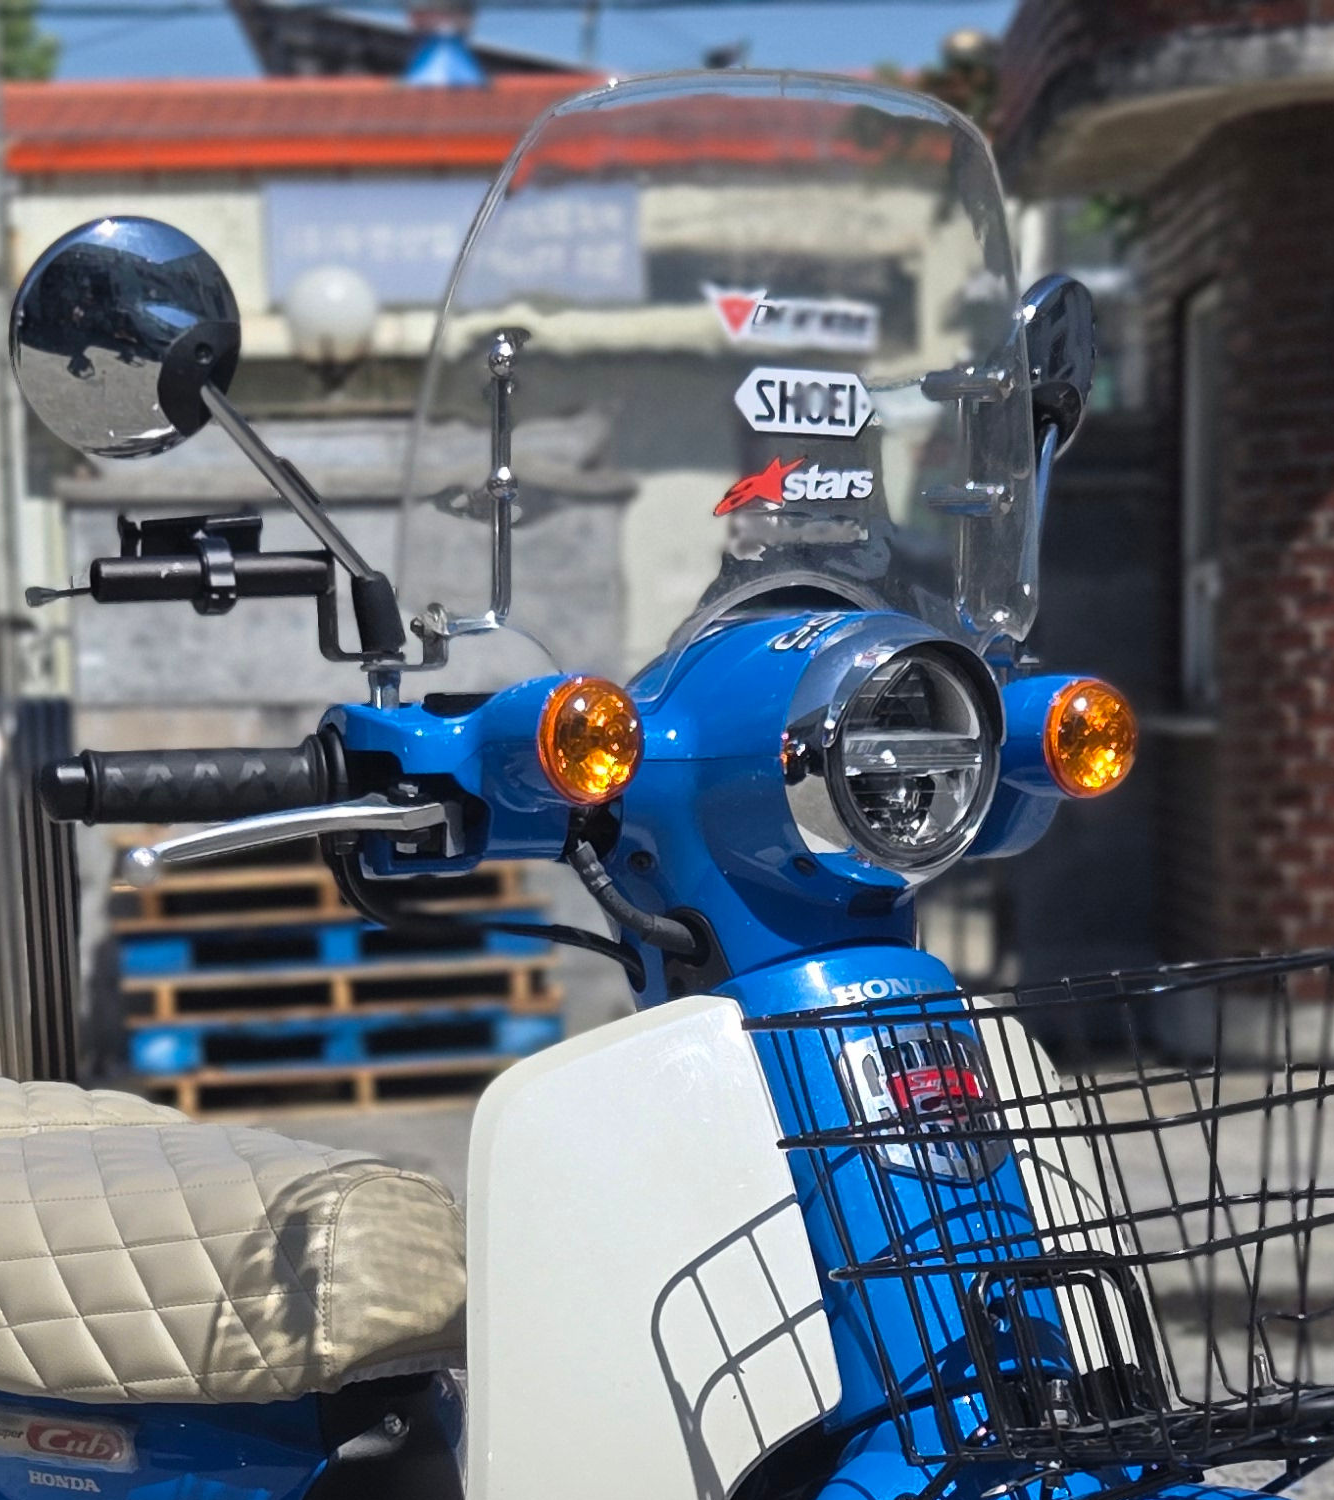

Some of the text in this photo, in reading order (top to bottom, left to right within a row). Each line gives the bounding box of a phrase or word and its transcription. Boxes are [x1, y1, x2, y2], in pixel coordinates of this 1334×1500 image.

[754, 379, 857, 427] SHOEI
[39, 1429, 111, 1455] Cub
[28, 1470, 101, 1493] HONDA
